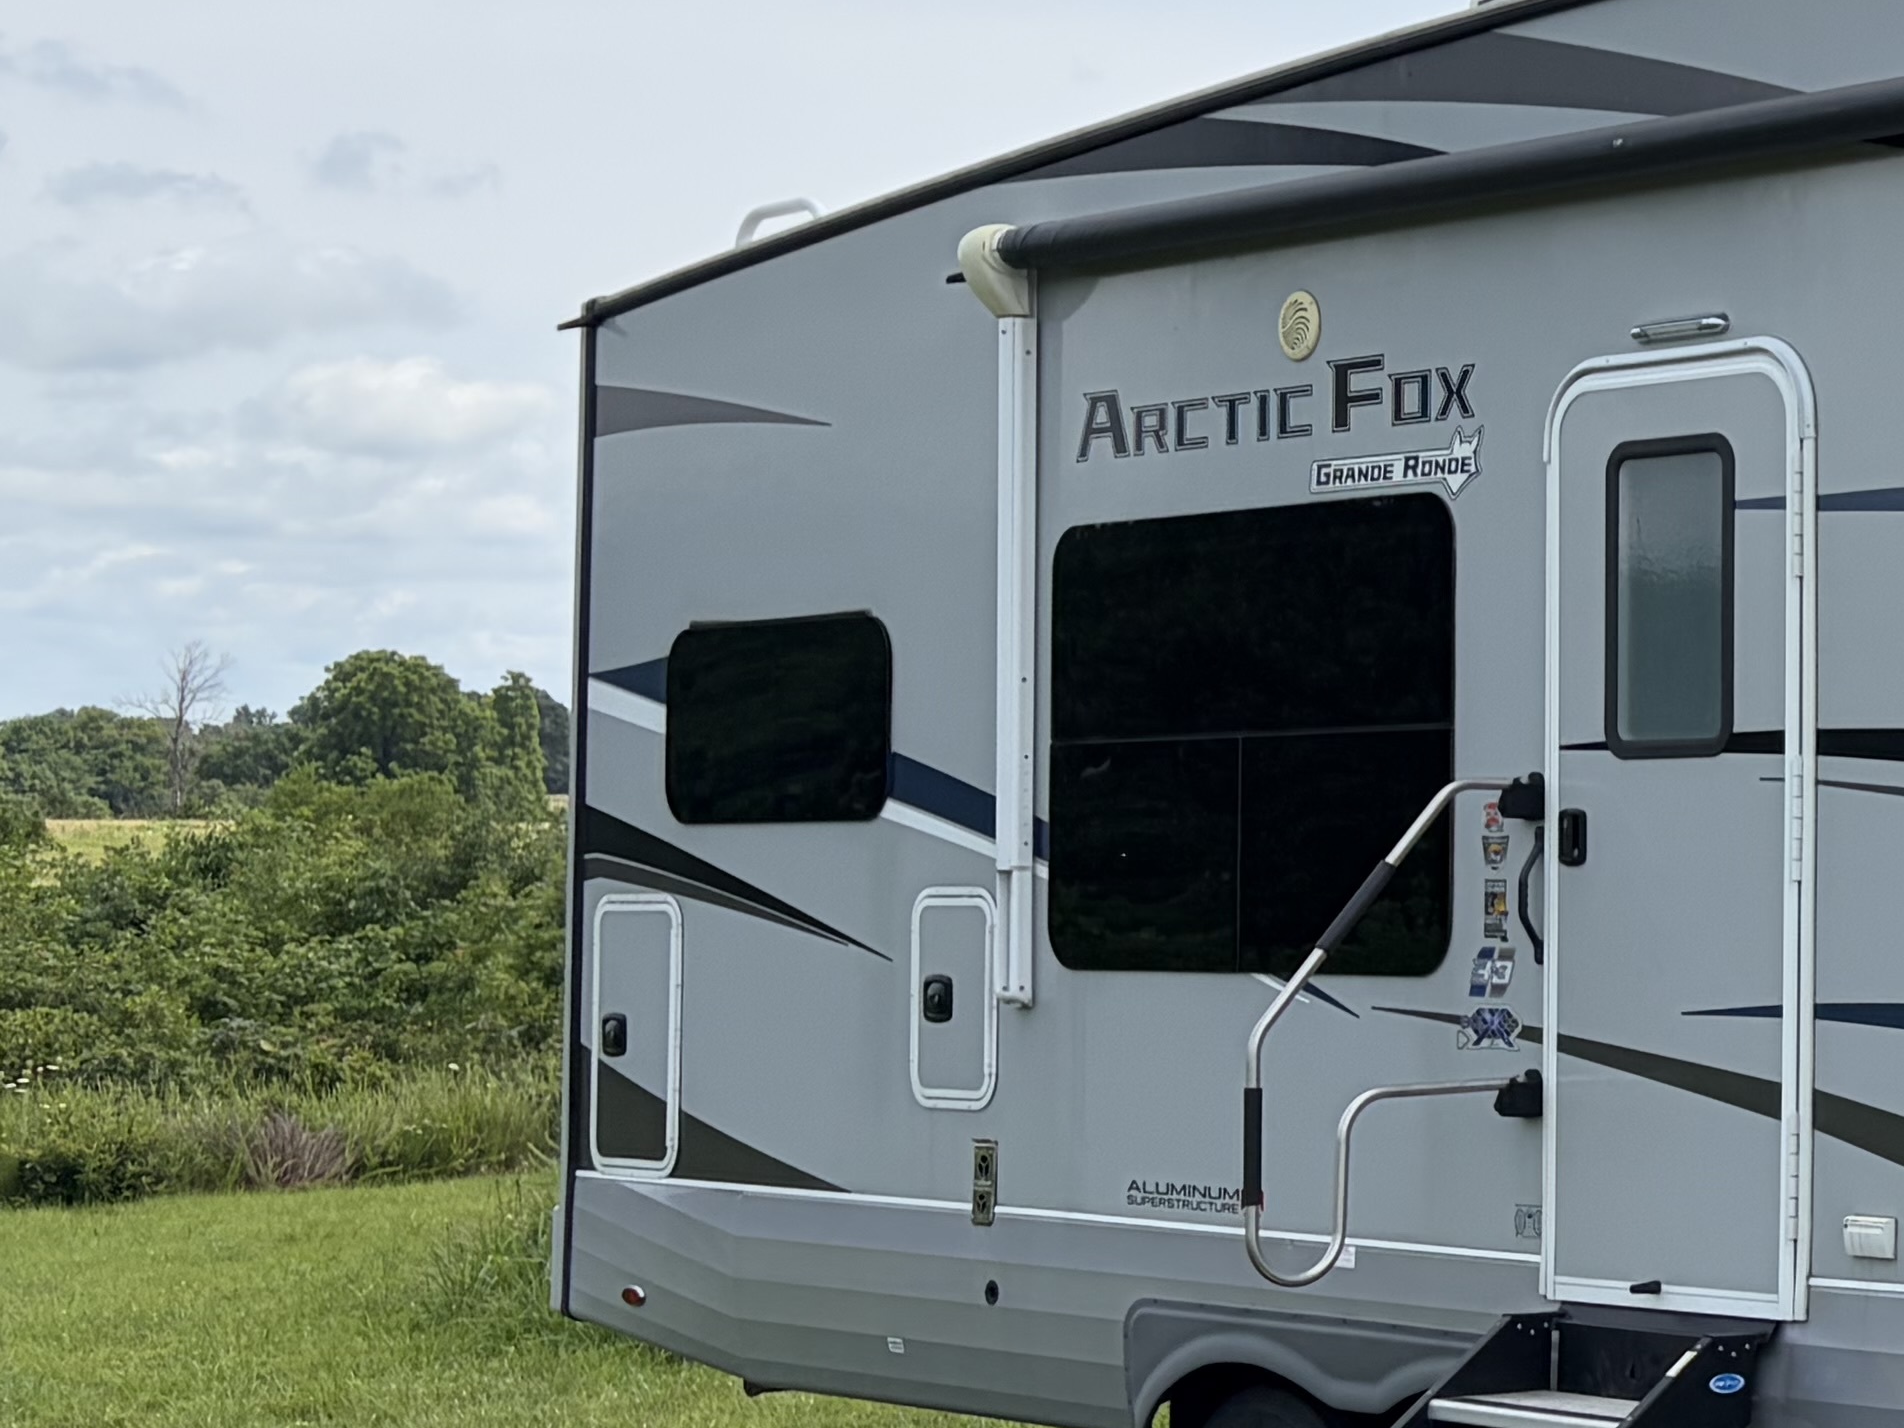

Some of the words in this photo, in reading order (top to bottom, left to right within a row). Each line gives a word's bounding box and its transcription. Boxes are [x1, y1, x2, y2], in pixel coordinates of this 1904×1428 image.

[1076, 383, 1314, 463] ARCTIC
[1326, 353, 1476, 434] FOX
[1315, 460, 1395, 486] GRANDE
[1402, 454, 1473, 479] RONDE
[1127, 1179, 1240, 1202] ALUMINUM
[1126, 1194, 1240, 1215] SUPERSTRUCTURE
